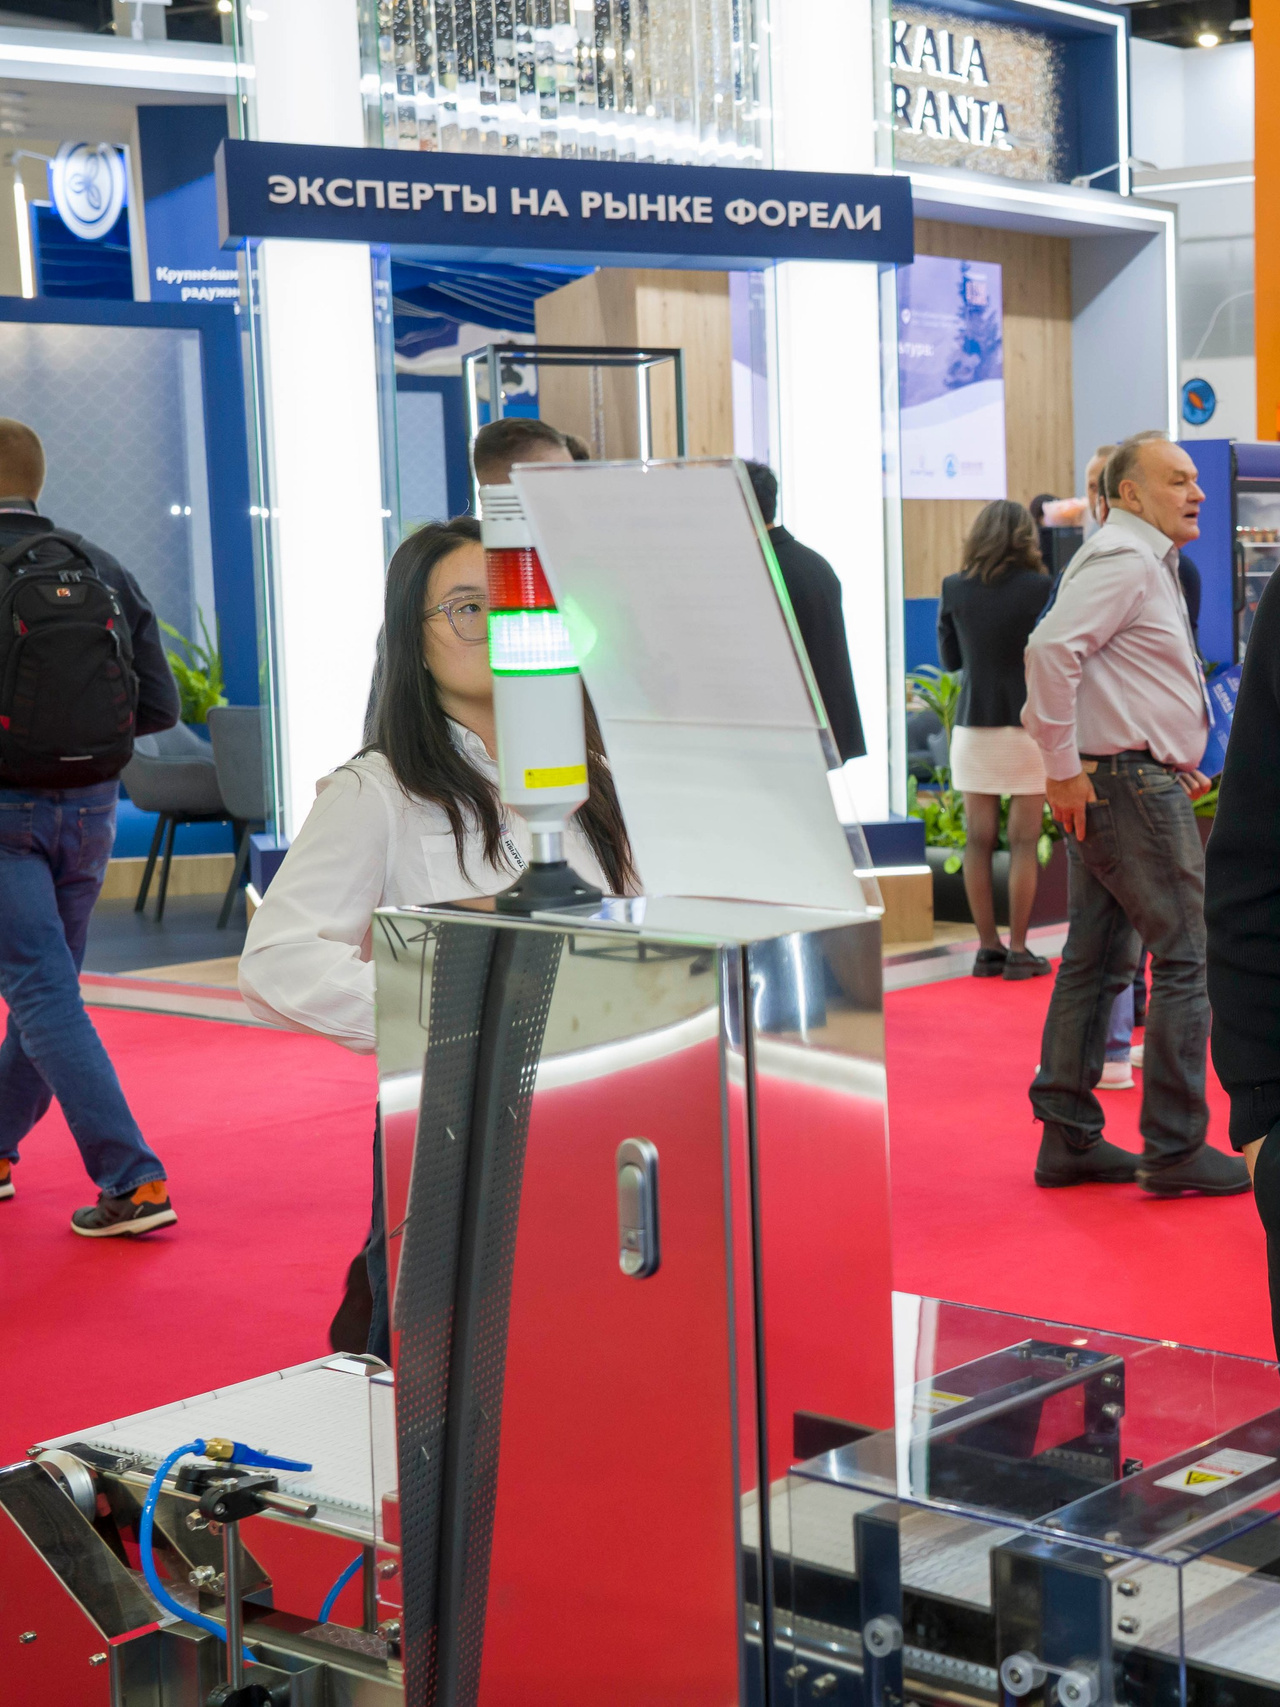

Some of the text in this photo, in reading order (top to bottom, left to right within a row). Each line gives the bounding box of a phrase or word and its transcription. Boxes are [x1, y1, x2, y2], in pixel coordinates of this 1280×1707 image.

[882, 18, 989, 87] KALA
[882, 81, 1013, 151] RANTA
[268, 175, 882, 231] ЭКСПЕРТЫ НА РЫНКЕ ФОРЕЛИ
[156, 266, 240, 284] Крупнейши
